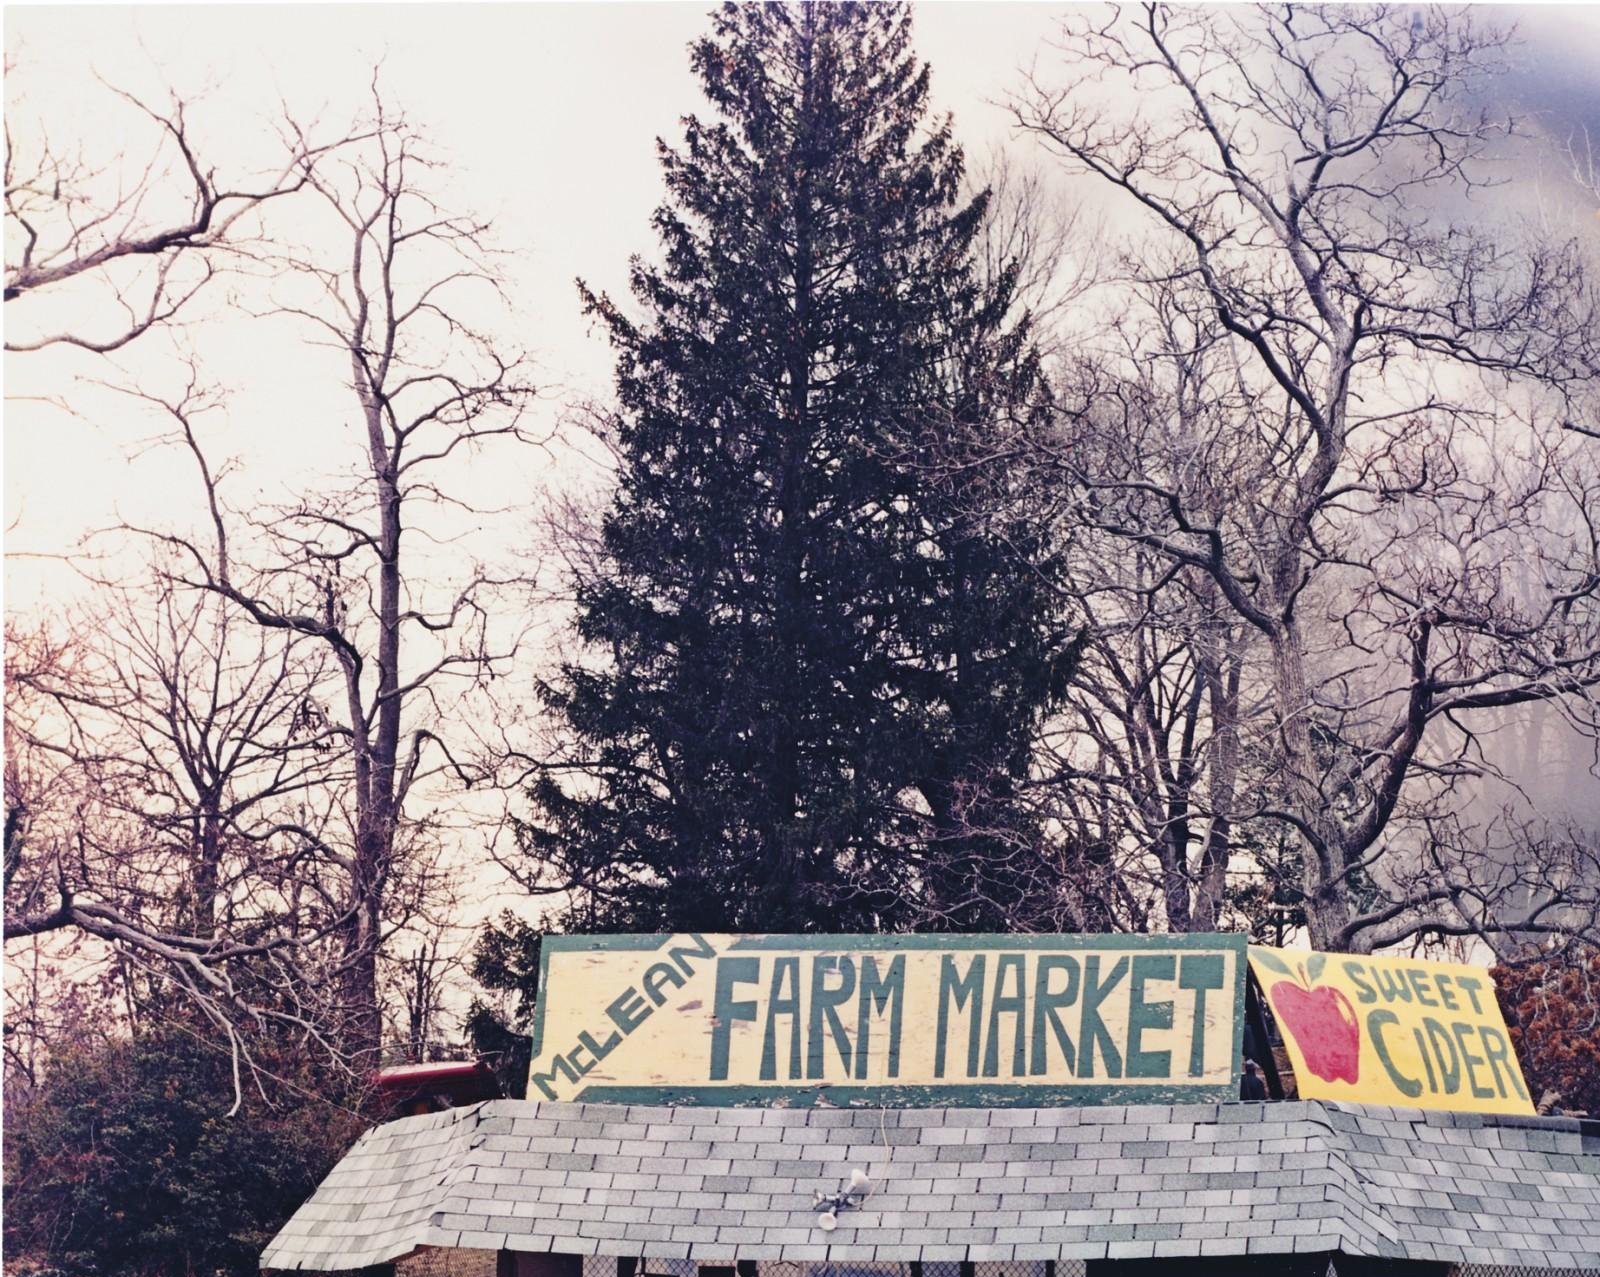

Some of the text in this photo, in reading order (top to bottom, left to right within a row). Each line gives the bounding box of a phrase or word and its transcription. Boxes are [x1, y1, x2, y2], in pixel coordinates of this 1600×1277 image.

[709, 953, 1225, 1081] FARM MARKET
[1342, 961, 1482, 1015] SWEET
[1366, 1009, 1530, 1101] CIDER
